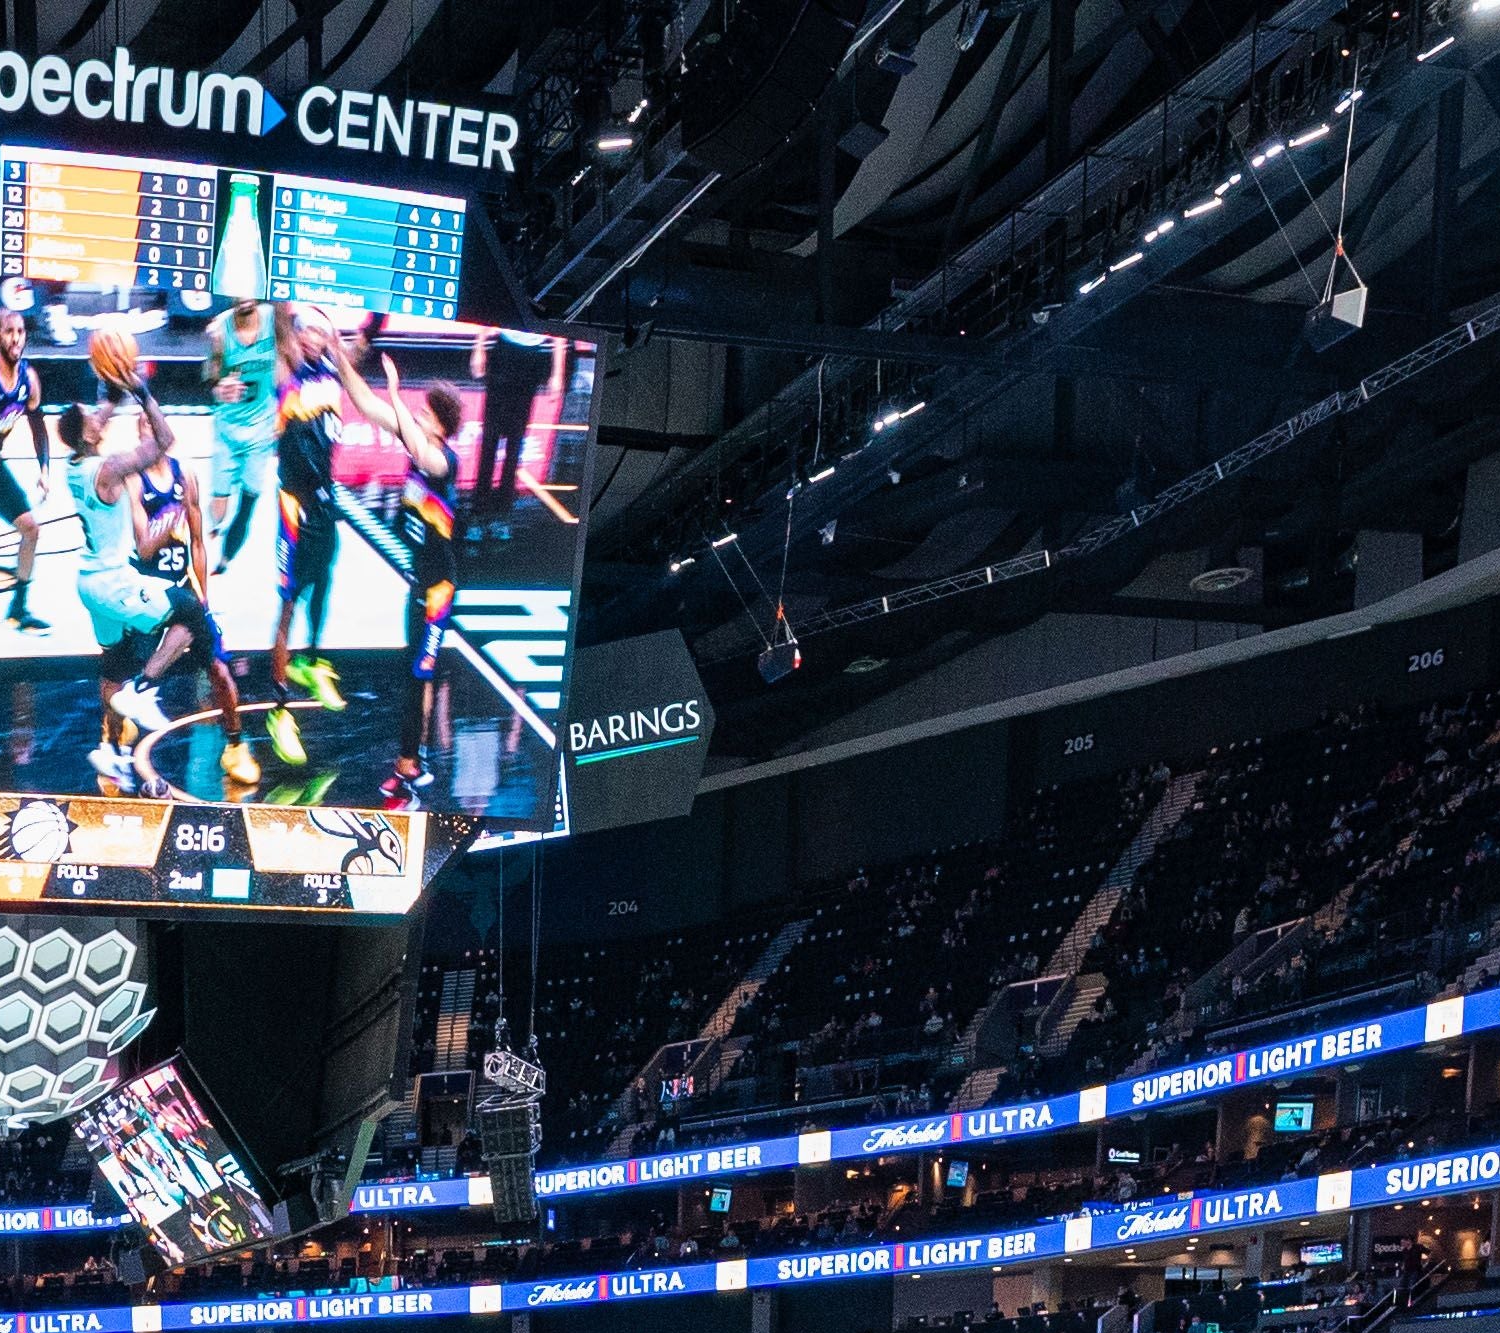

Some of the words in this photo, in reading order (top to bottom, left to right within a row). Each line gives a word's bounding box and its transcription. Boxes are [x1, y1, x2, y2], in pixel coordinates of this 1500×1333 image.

[295, 80, 522, 174] CENTER
[158, 545, 187, 571] 25
[1408, 654, 1444, 673] 206
[570, 700, 700, 751] BARINGS
[1063, 735, 1094, 754] 205
[175, 822, 226, 853] 8:16
[57, 866, 98, 881] FOULS
[169, 872, 202, 891] 2nd
[303, 874, 341, 890] FOULS
[608, 900, 639, 914] 204
[1133, 1061, 1232, 1104] SUPERIOR
[1249, 1039, 1316, 1077] LIGHT
[1322, 1024, 1381, 1060] BEER
[862, 1122, 945, 1151] Michelob
[967, 1105, 1054, 1137] ULTRA
[639, 1153, 703, 1181] LIGHT
[707, 1146, 761, 1171] BEER
[359, 1185, 436, 1207] ULTRA
[1117, 1205, 1188, 1239] Michelob
[1205, 1190, 1282, 1225] ULTRA
[778, 1250, 889, 1280] SUPERIOR
[909, 1240, 982, 1266] LIGHT
[988, 1232, 1035, 1258] BEER
[527, 1281, 594, 1306] Michelob
[612, 1271, 685, 1296] ULTRA
[30, 1313, 102, 1333] ULTRA
[191, 1302, 293, 1325] SUPERIOR
[310, 1297, 373, 1318] LIGHT
[379, 1294, 432, 1314] BEER
